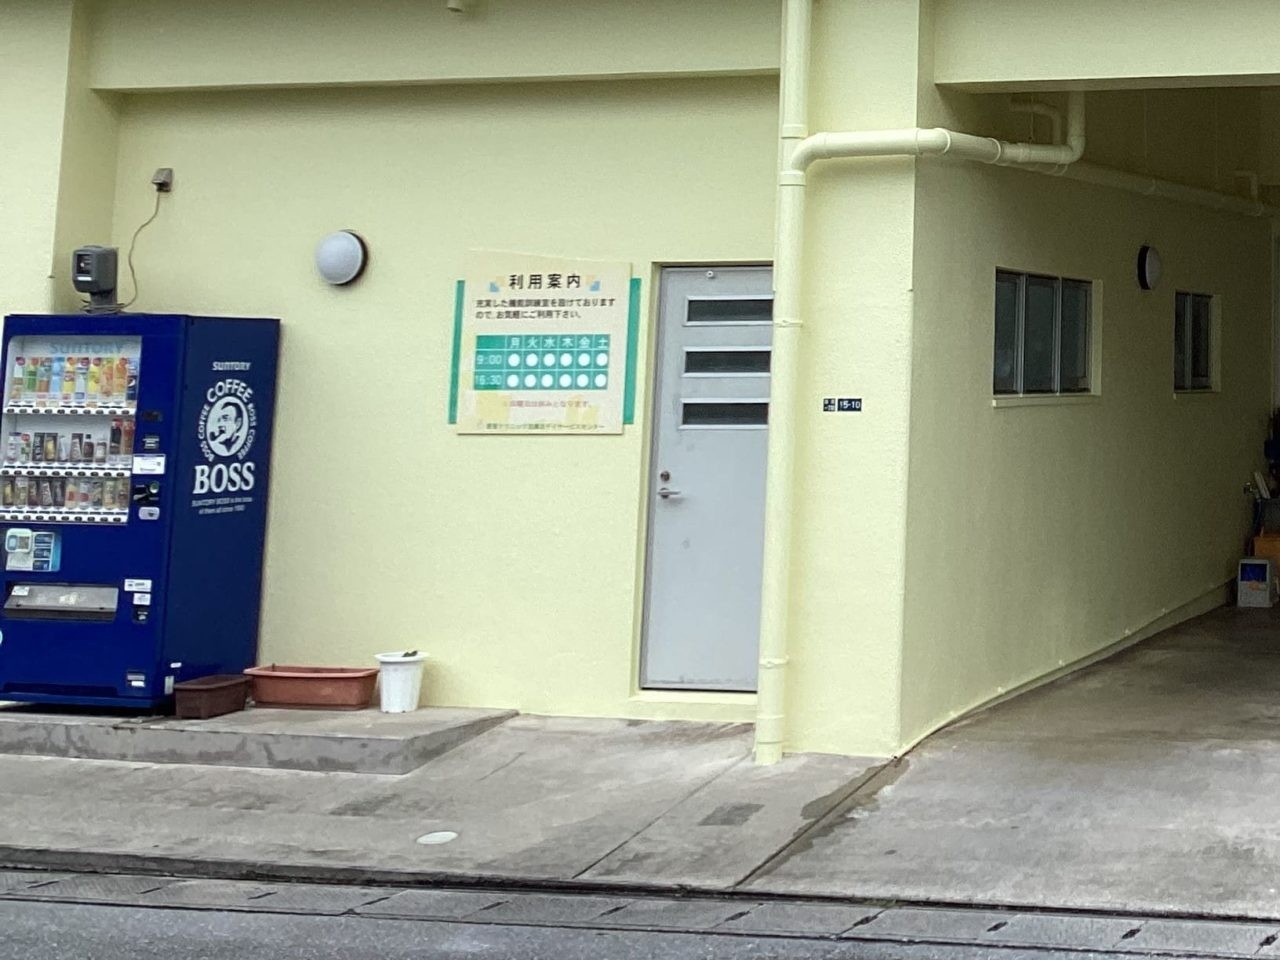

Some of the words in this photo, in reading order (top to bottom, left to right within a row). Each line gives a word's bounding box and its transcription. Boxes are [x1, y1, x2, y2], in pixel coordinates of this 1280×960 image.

[509, 273, 581, 290] 利用案内
[207, 378, 253, 403] COFFEE
[839, 400, 861, 409] 15-10
[192, 461, 256, 494] BOSS
